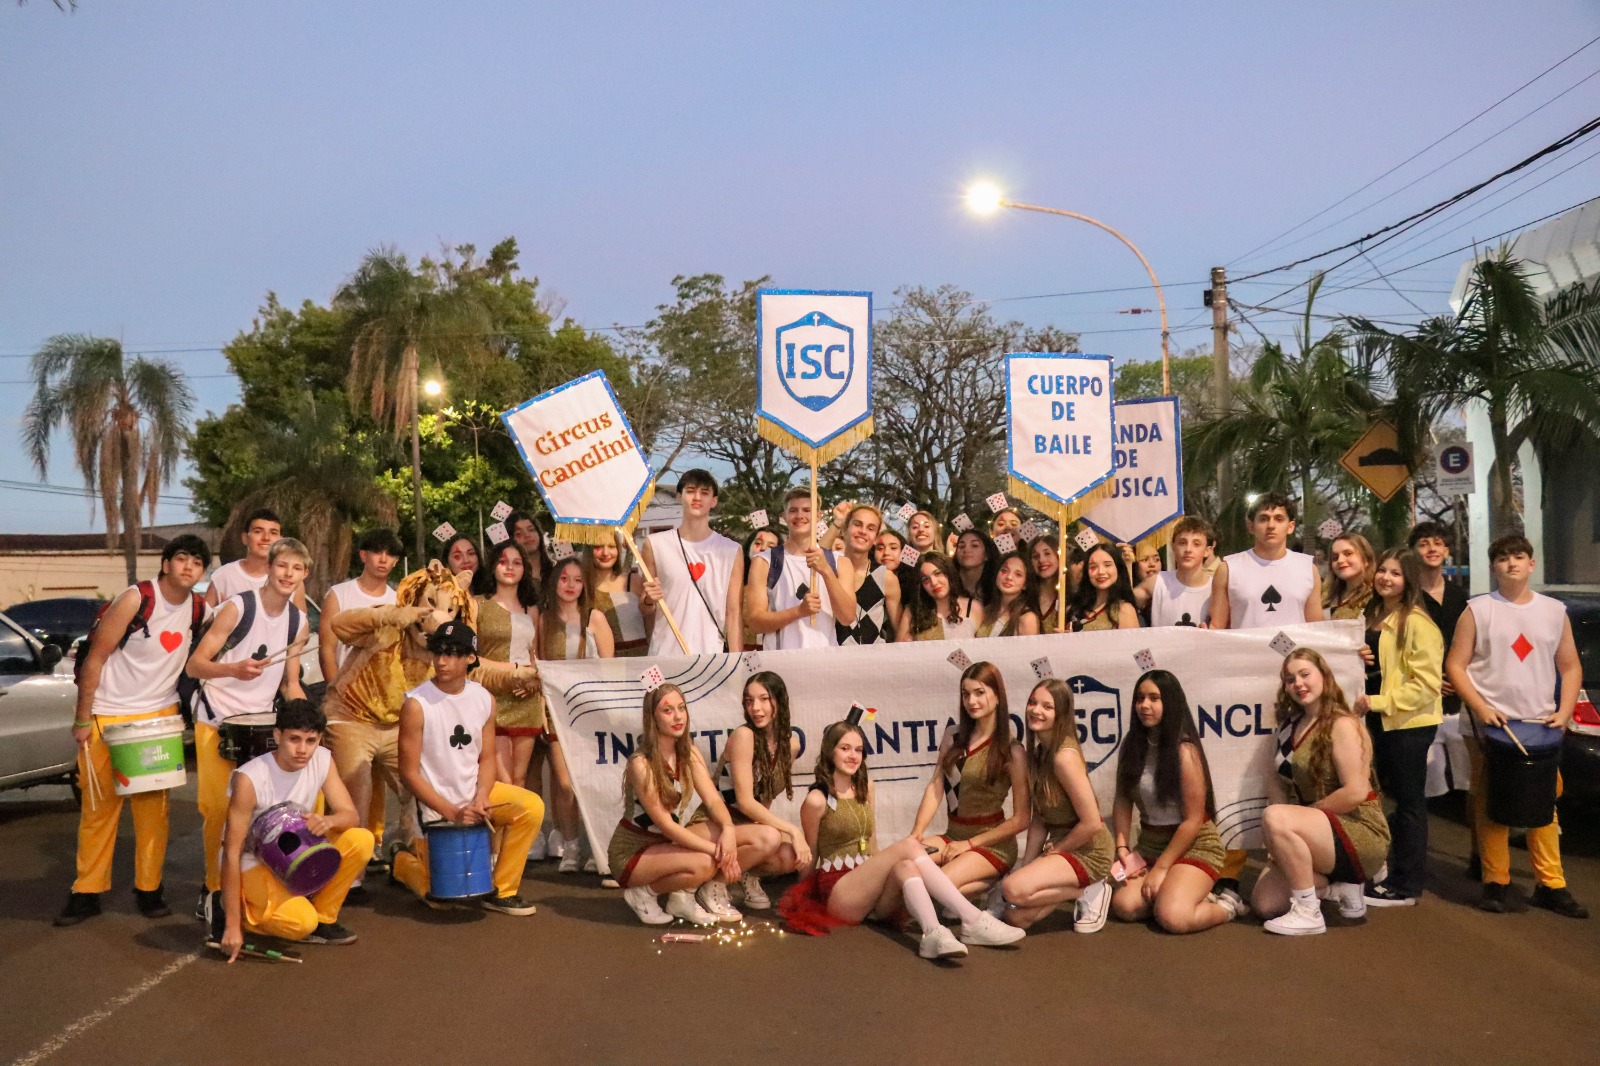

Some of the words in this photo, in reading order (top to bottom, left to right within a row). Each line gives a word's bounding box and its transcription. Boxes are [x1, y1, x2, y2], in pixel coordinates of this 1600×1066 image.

[785, 343, 845, 380] ISC
[1027, 374, 1103, 397] CUERPO
[1052, 401, 1076, 422] DE
[535, 411, 613, 456] Circus
[1035, 434, 1092, 455] BAILE
[1115, 423, 1163, 444] NDA
[540, 430, 635, 488] Canclini
[1115, 449, 1138, 469] DE
[1448, 453, 1461, 467] E
[1111, 476, 1169, 498] USICA
[1074, 708, 1116, 745] SC
